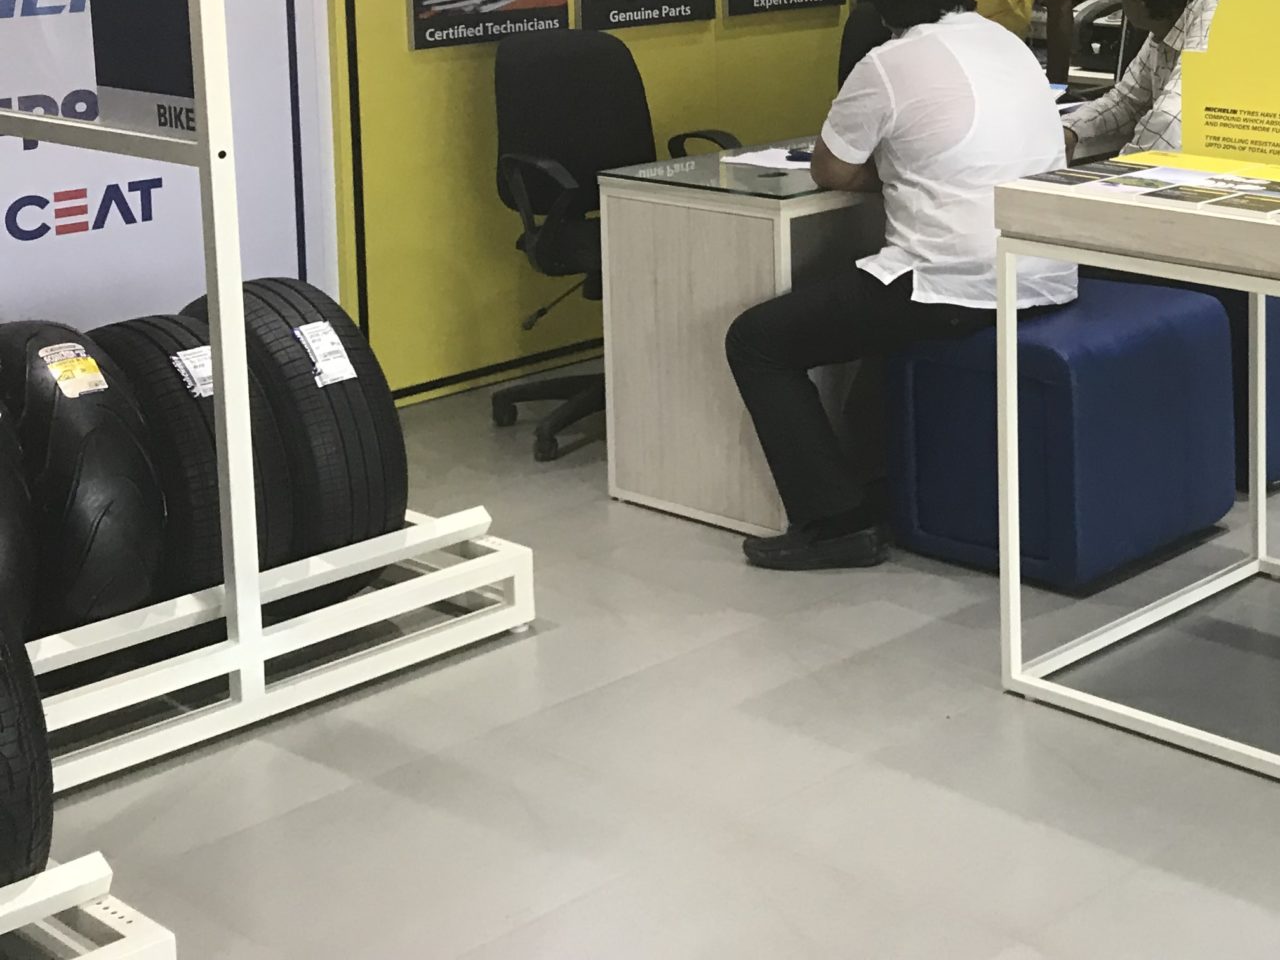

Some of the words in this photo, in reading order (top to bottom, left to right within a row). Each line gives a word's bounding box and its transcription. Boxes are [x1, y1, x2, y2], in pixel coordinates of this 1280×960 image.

[609, 9, 658, 22] Genuine
[661, 5, 691, 18] Parts
[425, 24, 483, 43] Certified
[486, 17, 560, 35] Technicians
[1205, 107, 1238, 115] MICHELIN
[1205, 114, 1242, 122] COMPOUND
[1219, 122, 1250, 131] PROVIDES
[1248, 146, 1267, 154] TOTAL
[4, 177, 163, 241] CEAT
